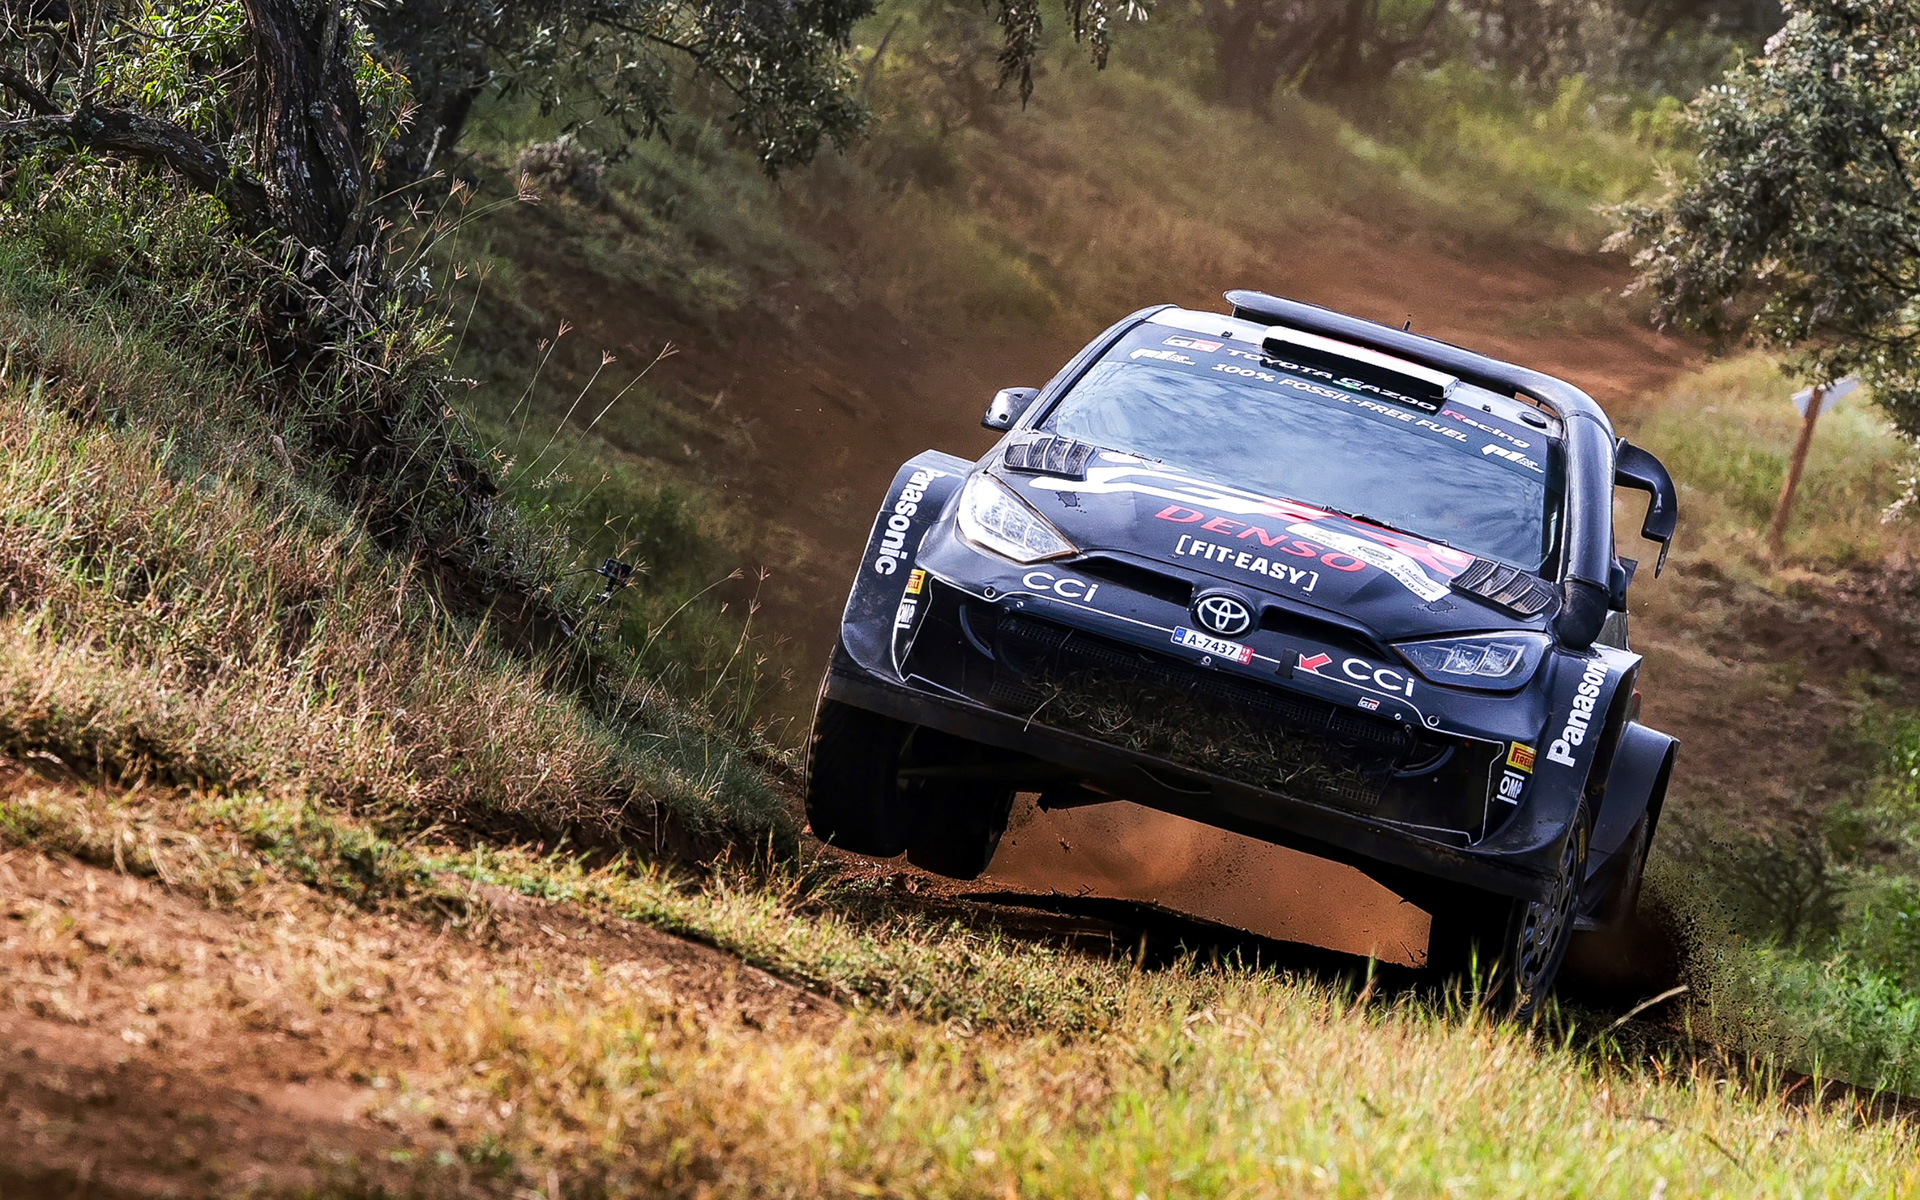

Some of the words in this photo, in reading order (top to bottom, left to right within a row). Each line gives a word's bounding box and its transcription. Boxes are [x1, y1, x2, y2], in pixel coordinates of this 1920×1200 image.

[1211, 363, 1276, 383] 100%
[1278, 378, 1417, 423] FOSSIL-FREE
[1415, 418, 1468, 443] FUEL
[1226, 348, 1334, 379] TOYOTA
[1339, 376, 1438, 411] GAZOO
[1442, 409, 1531, 449] Racing
[874, 467, 948, 576] Panasonic
[1154, 504, 1368, 572] DENSO
[1187, 634, 1237, 656] A-7437
[1499, 776, 1523, 799] OMP
